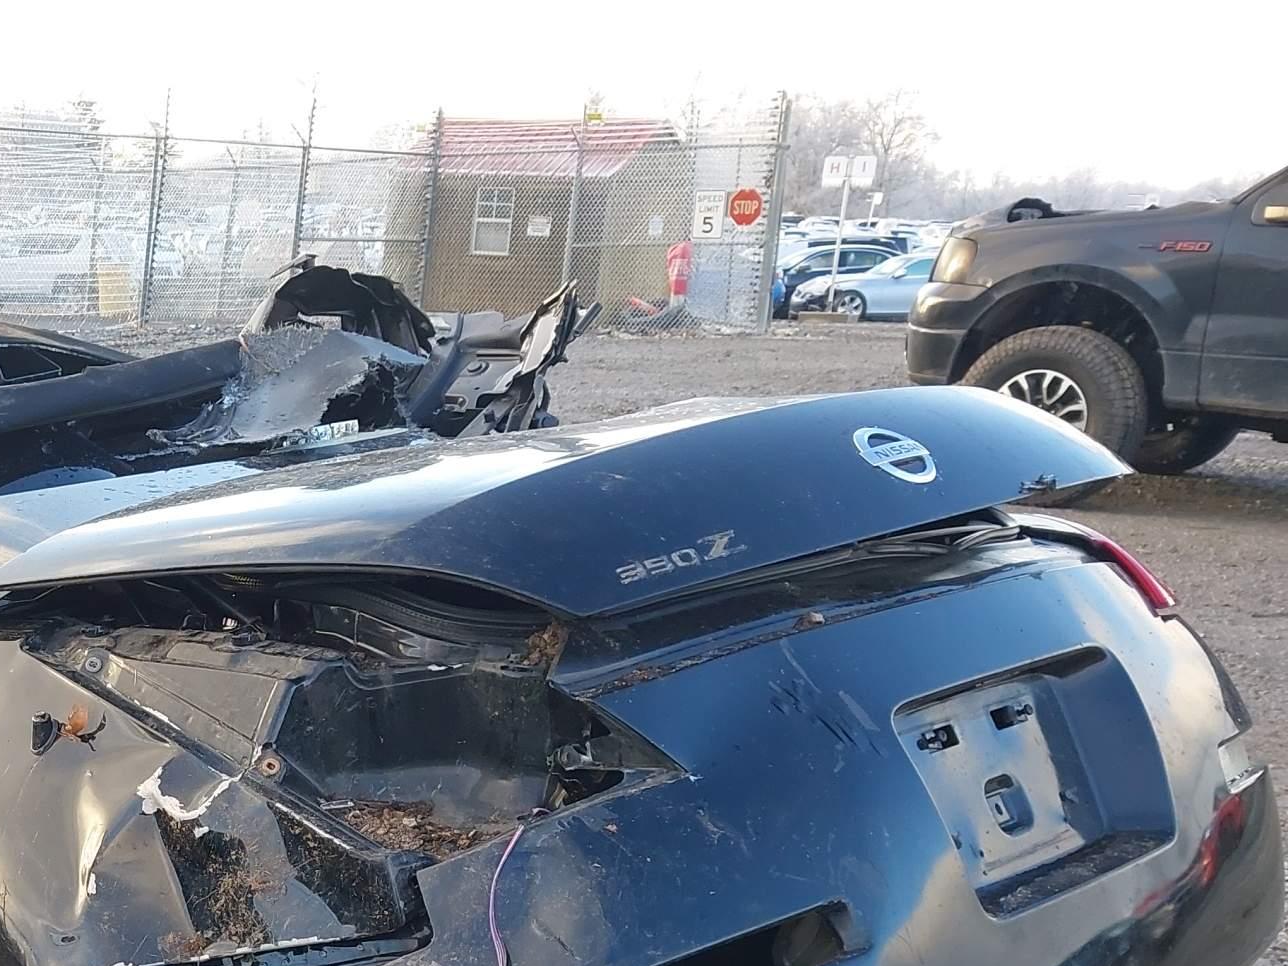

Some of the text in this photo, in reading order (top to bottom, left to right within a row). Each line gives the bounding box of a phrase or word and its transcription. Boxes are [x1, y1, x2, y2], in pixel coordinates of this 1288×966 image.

[830, 162, 841, 174] H
[697, 194, 723, 203] SPEED
[699, 205, 720, 213] LIMIT
[733, 200, 759, 215] STOP
[702, 216, 714, 233] 5
